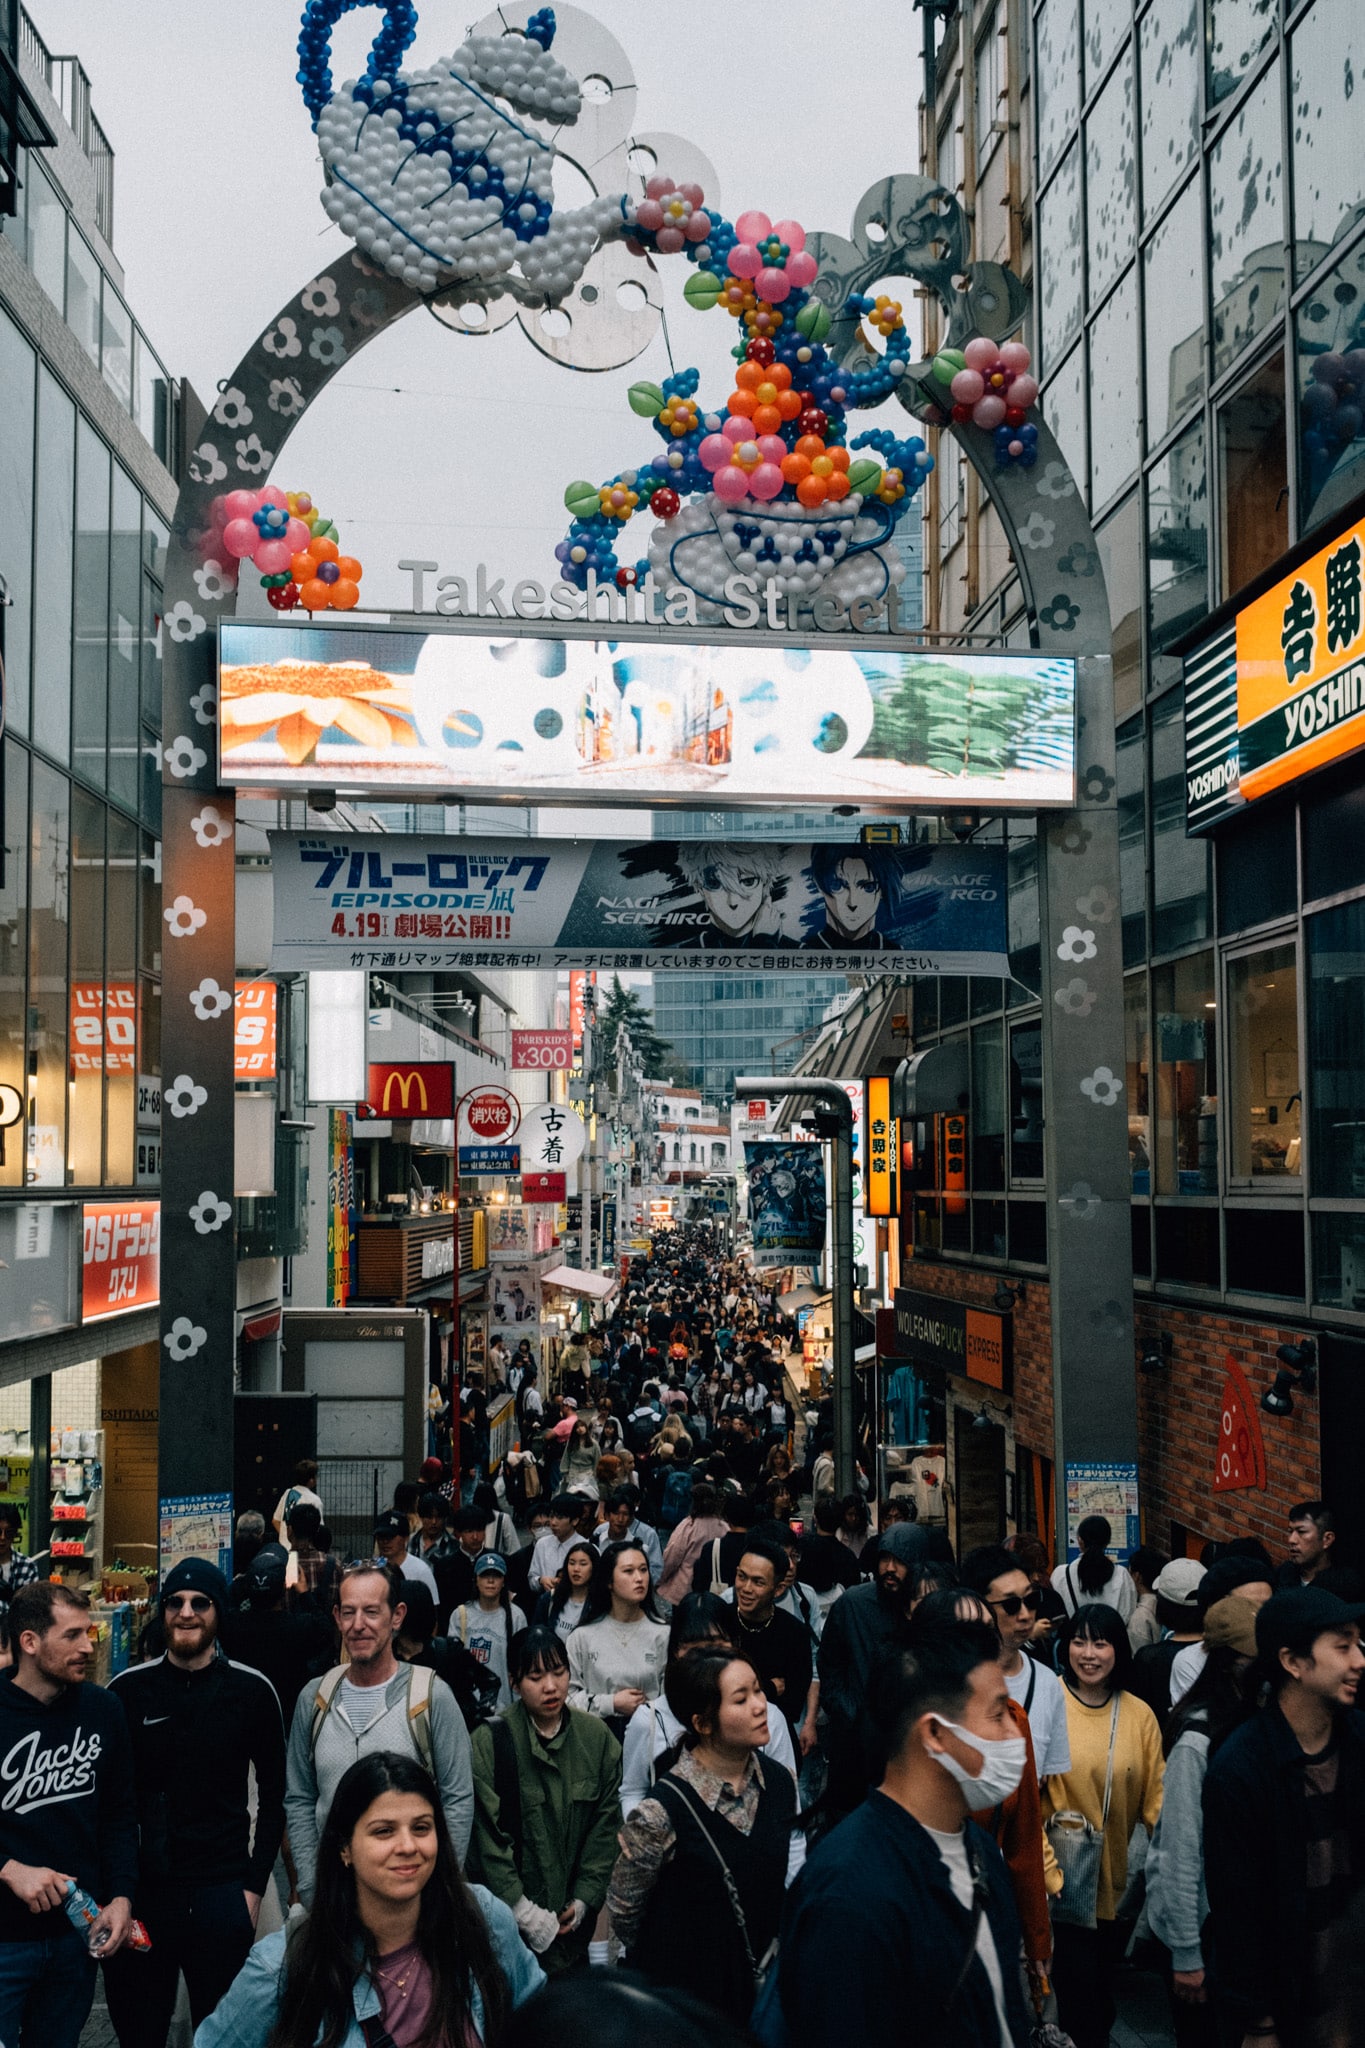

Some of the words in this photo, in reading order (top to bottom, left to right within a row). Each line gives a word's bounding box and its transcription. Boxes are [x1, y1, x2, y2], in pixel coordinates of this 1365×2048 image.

[398, 560, 698, 627] Takeshita
[723, 574, 905, 635] Street
[1187, 754, 1240, 804] YOSHINOY
[300, 846, 551, 892] ブルーロック
[331, 892, 487, 909] EPISODE
[596, 896, 659, 910] NAGI
[950, 888, 998, 901] REO
[331, 912, 382, 937] 4.19
[393, 914, 512, 940] 劇場公開!!
[601, 911, 712, 926] SEISHIRO
[517, 1047, 567, 1067] ¥300
[471, 1106, 509, 1125] 消火栓
[540, 1107, 566, 1164] 古着
[108, 1265, 139, 1303] クスリ
[967, 1334, 1000, 1365] EXPRESS
